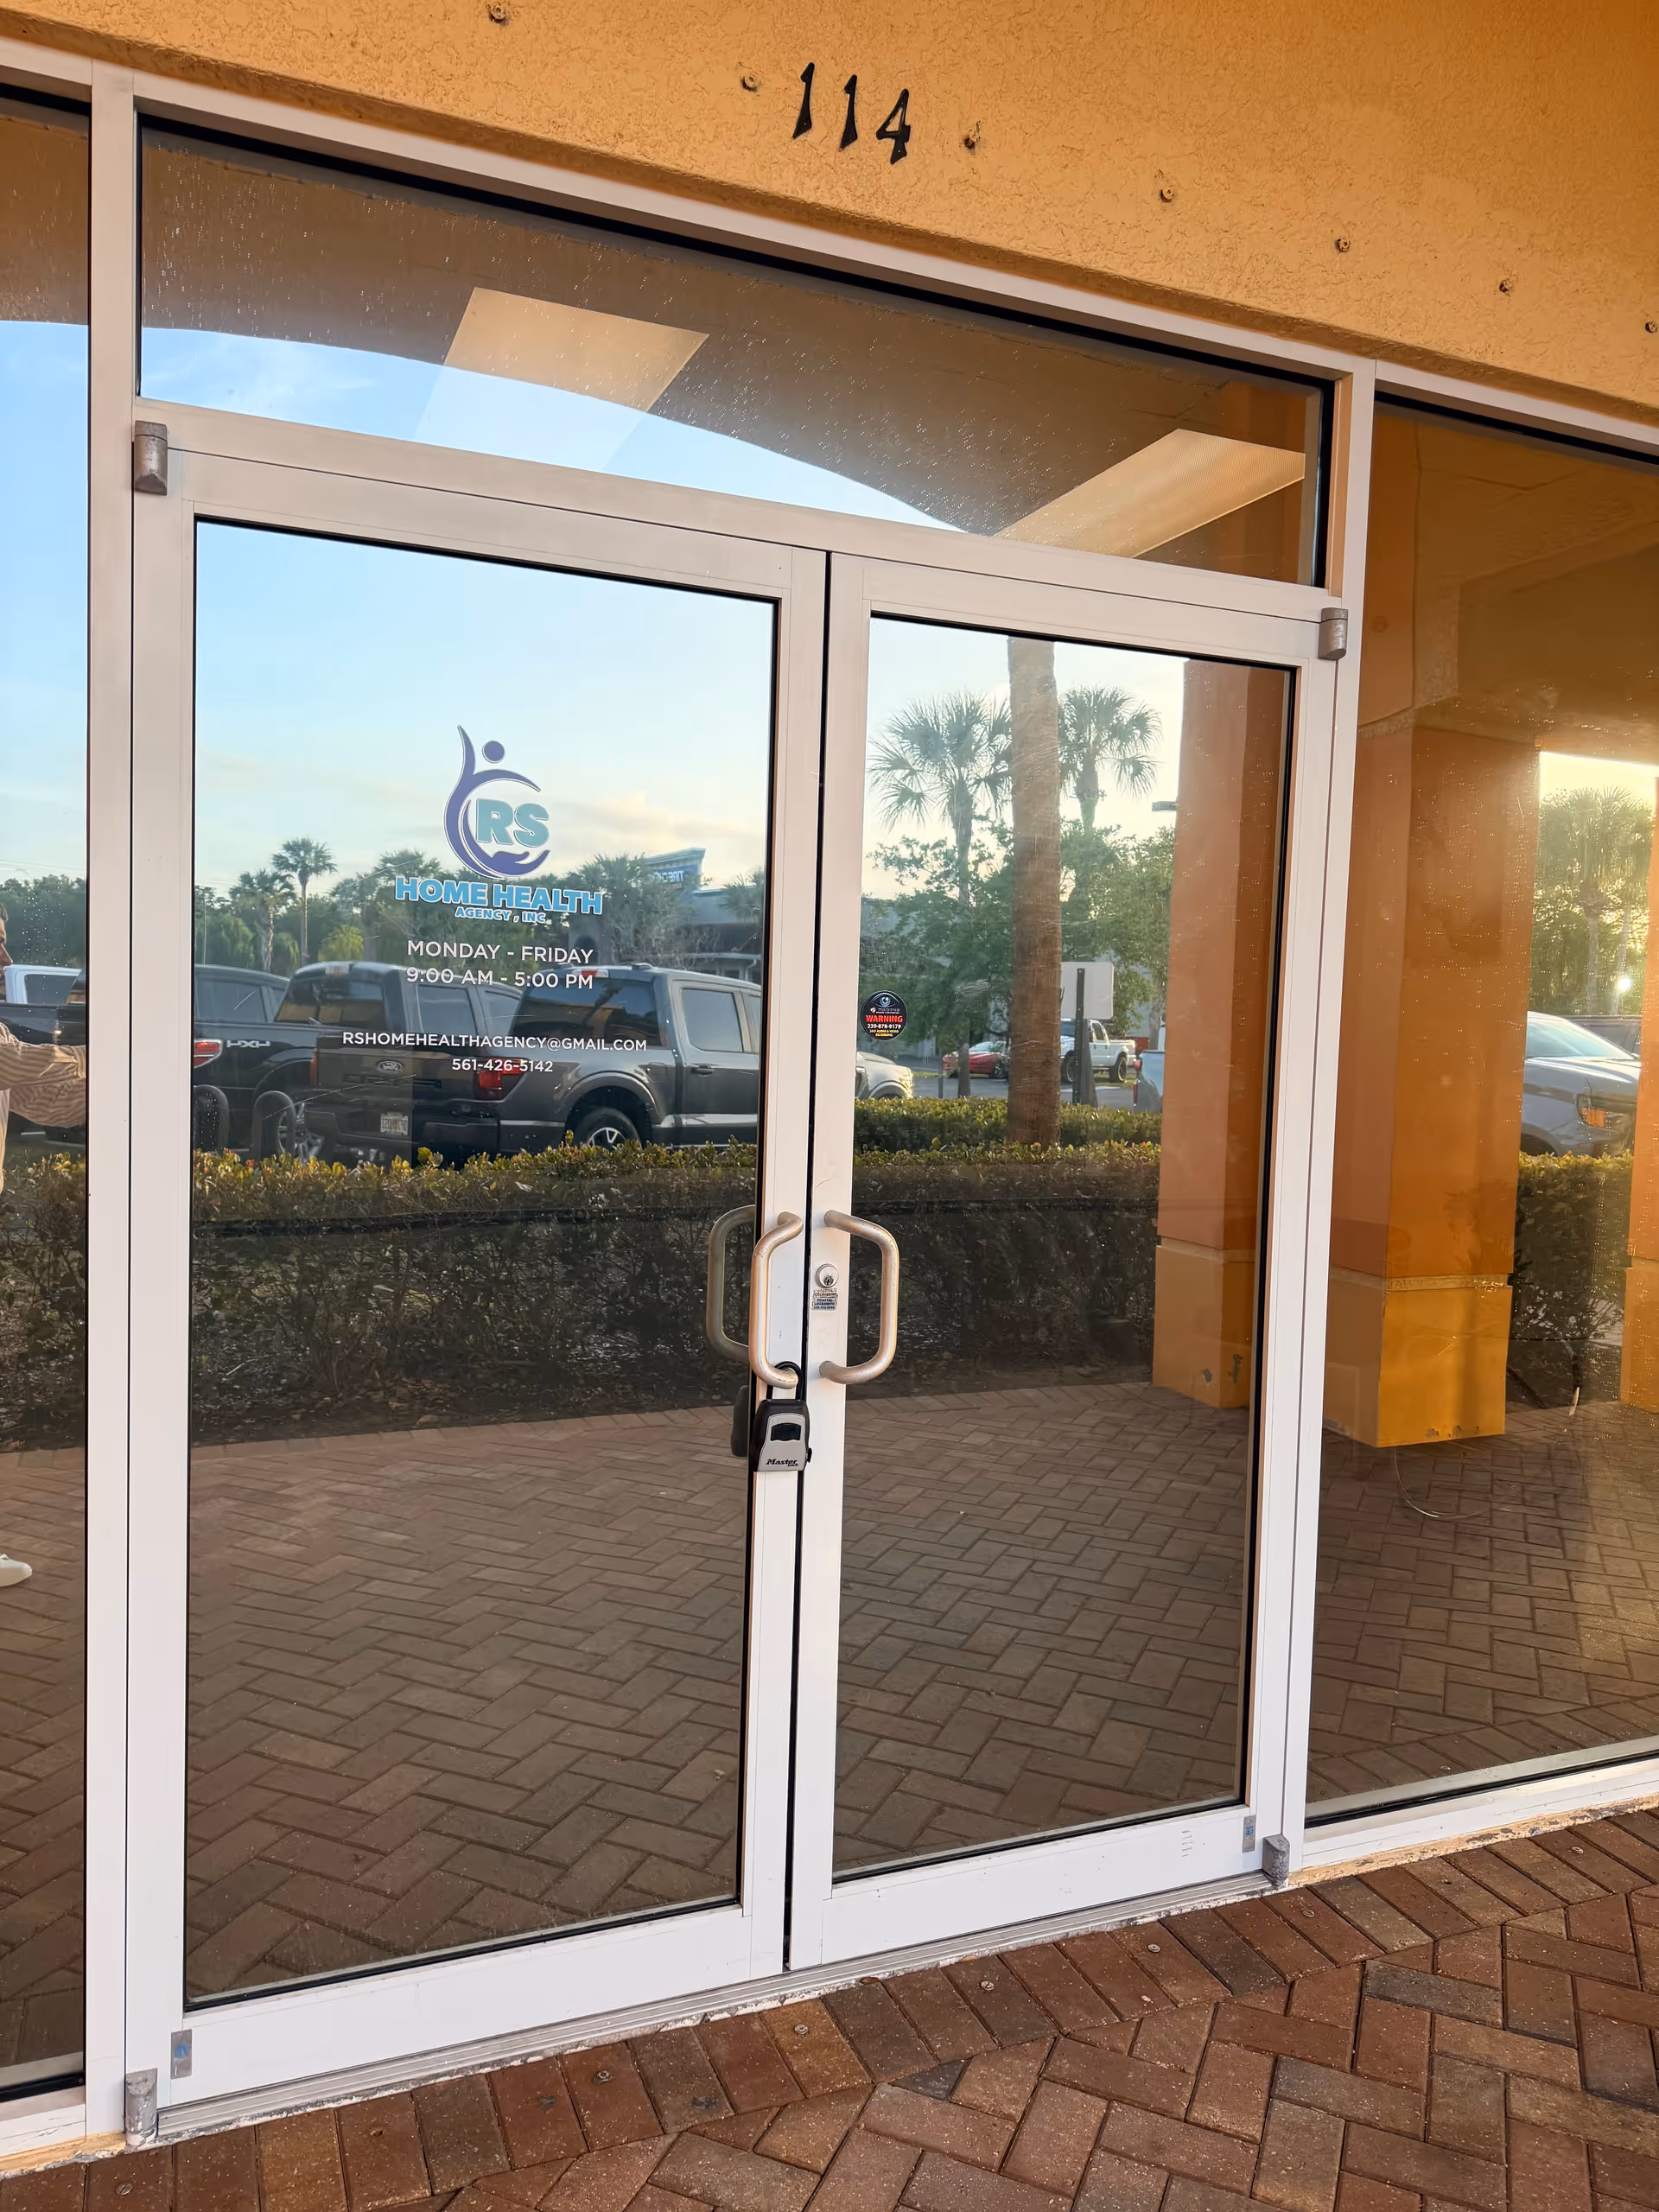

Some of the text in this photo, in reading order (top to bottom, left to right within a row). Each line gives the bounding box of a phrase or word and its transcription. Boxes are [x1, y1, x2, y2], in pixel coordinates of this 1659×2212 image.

[792, 62, 912, 165] 114
[476, 798, 550, 849] RS
[395, 877, 603, 915] HOME HEALTH
[407, 940, 501, 960] MONDAY
[521, 946, 594, 964] FRIDAY
[406, 967, 454, 983] 9:00
[461, 969, 493, 985] AM
[514, 971, 559, 988] 5:00
[565, 975, 593, 989] PM
[342, 1032, 647, 1052] RSHOMEHEALTHAGENCY@GMAIL.COM
[452, 1058, 554, 1073] 561-426-5142
